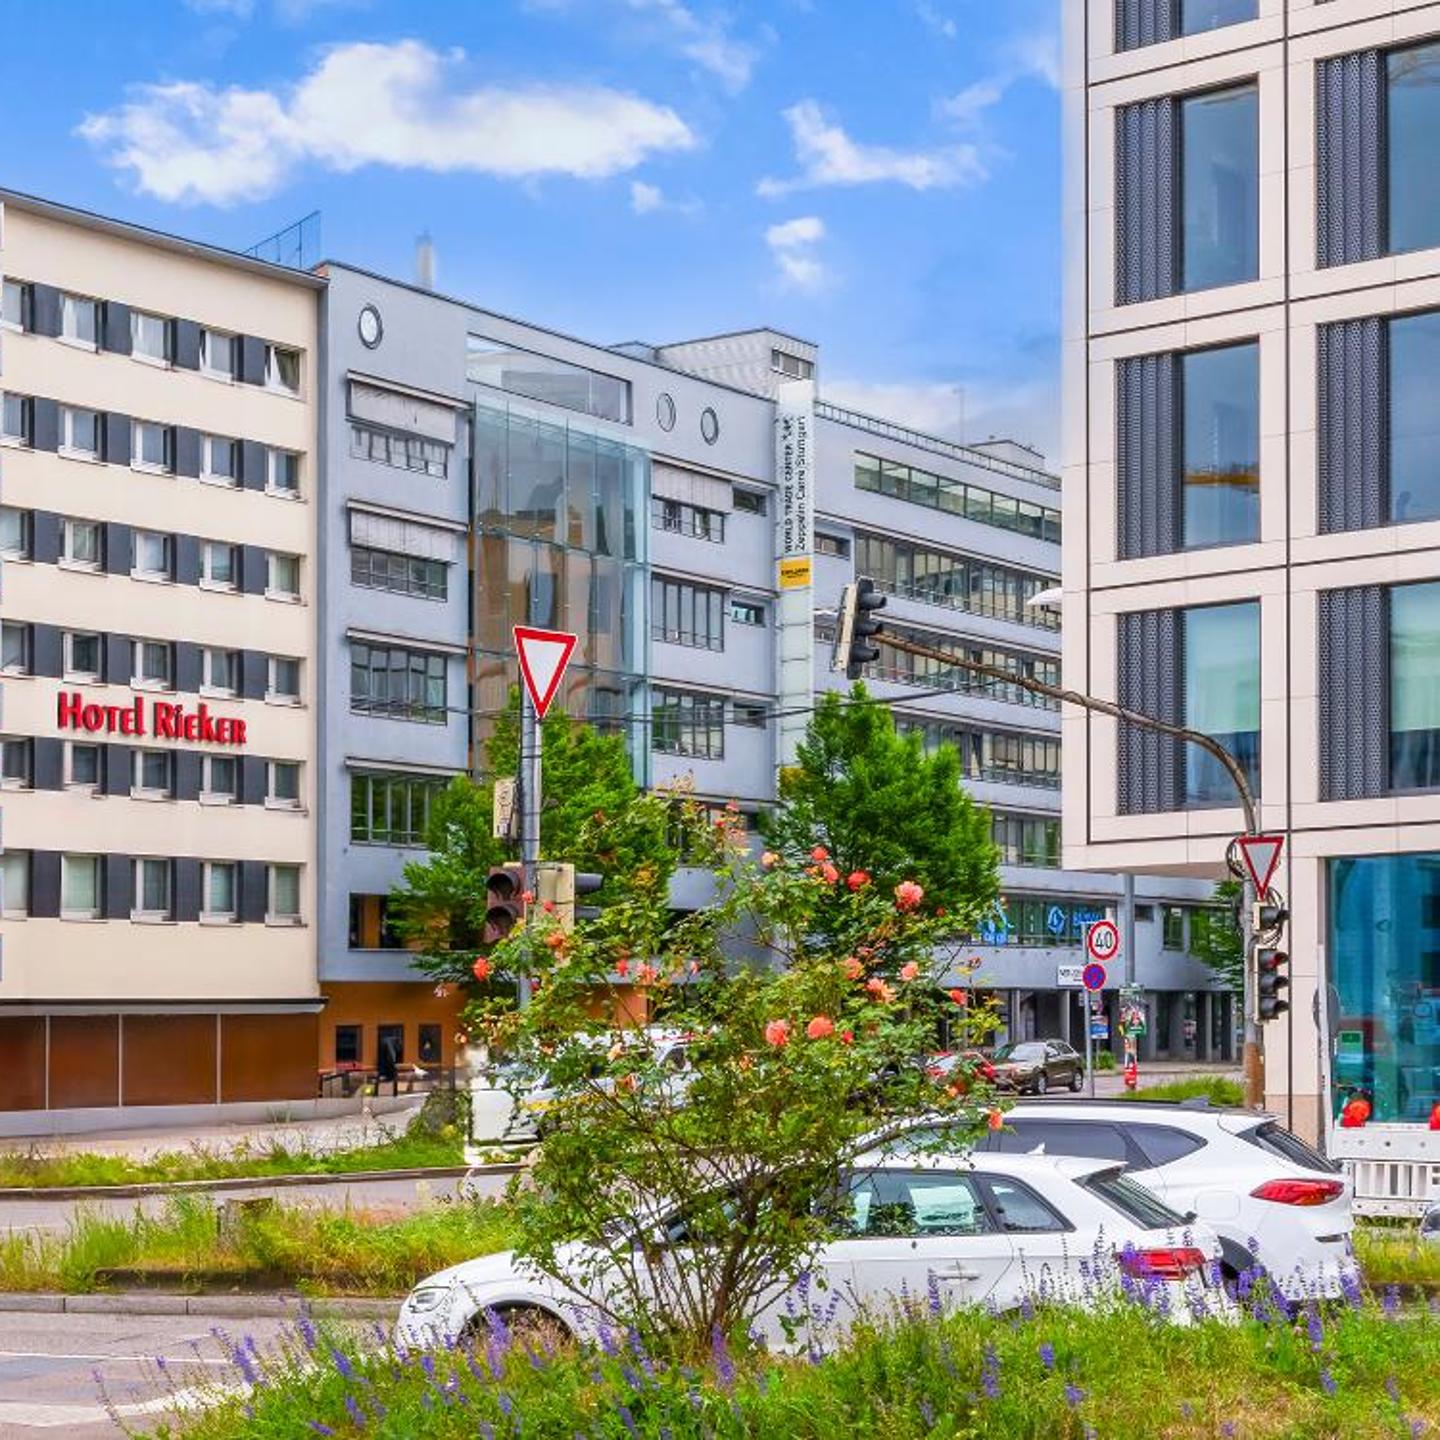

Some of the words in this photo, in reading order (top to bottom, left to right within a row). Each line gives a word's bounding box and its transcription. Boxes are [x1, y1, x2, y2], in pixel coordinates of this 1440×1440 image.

[784, 484, 793, 516] TRADE
[784, 518, 793, 554] WORLD
[1095, 931, 1113, 949] 40
